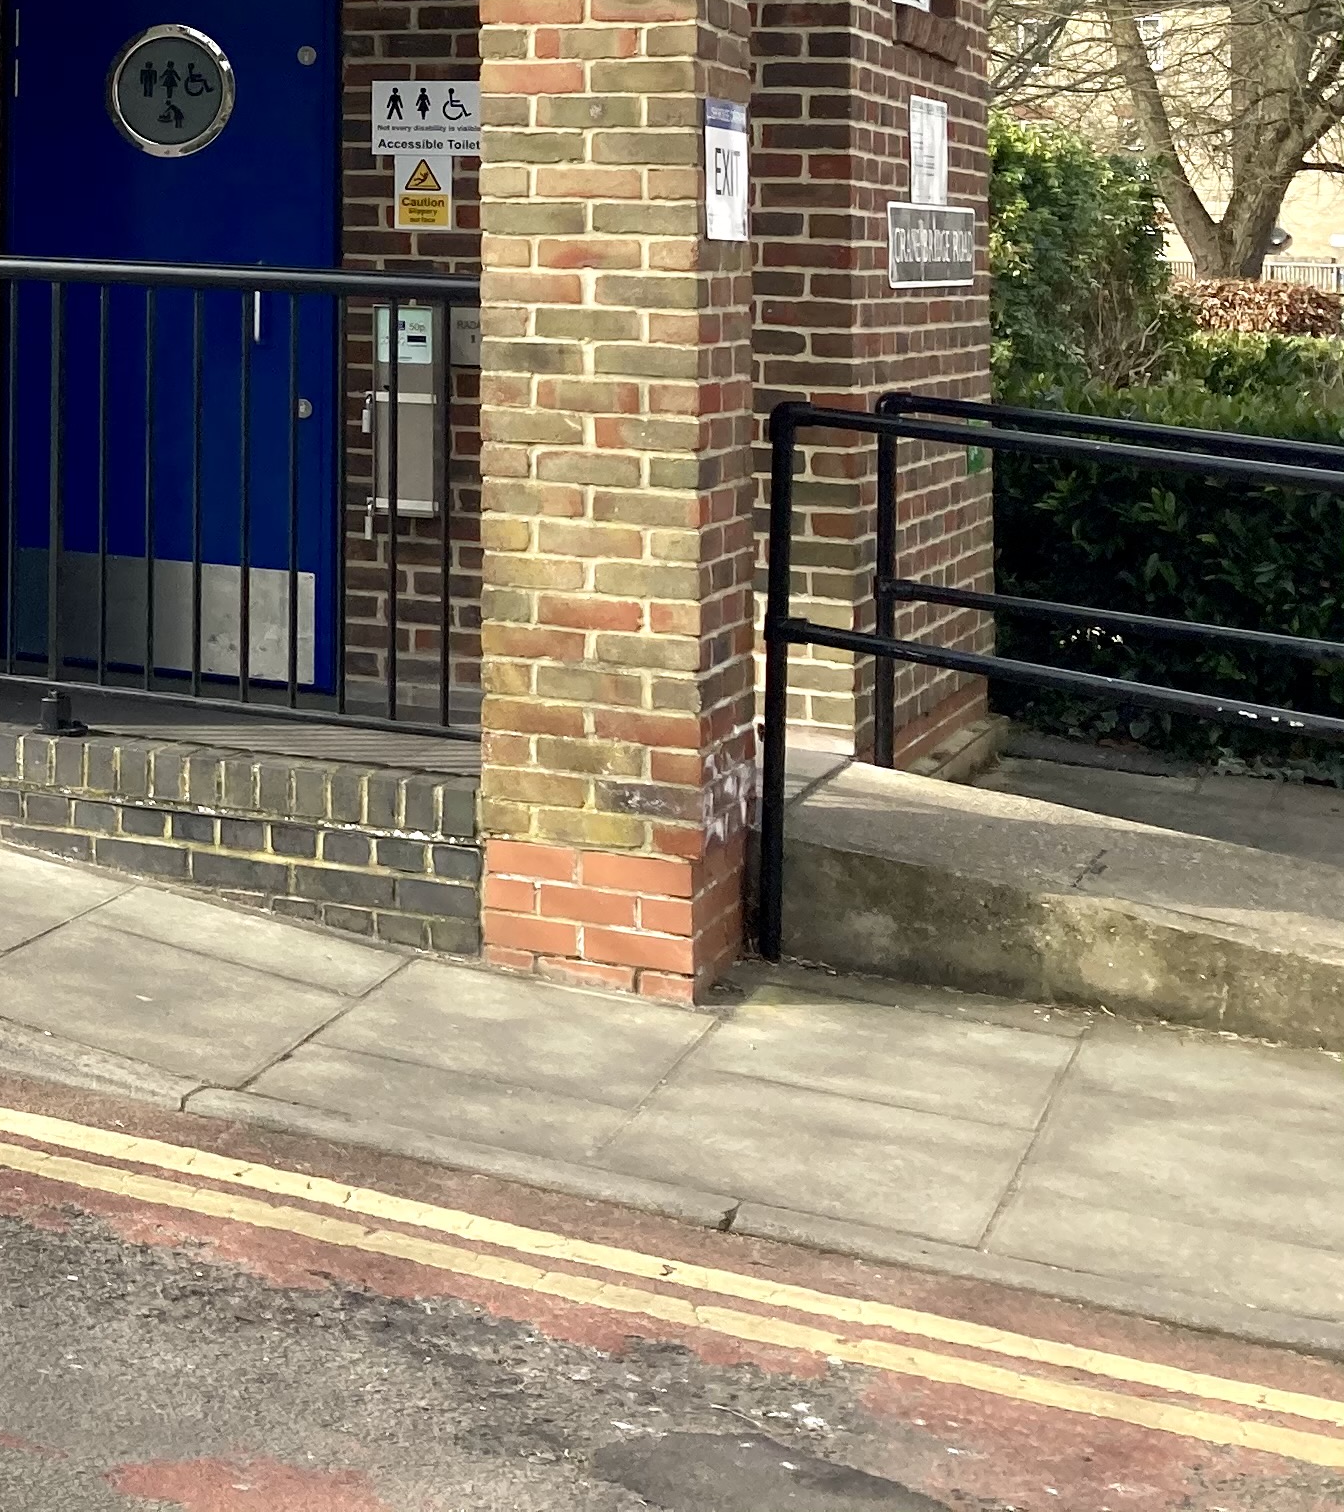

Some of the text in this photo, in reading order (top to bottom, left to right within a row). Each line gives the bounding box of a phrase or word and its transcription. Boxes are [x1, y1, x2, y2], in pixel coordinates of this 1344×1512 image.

[392, 125, 412, 133] every
[413, 125, 446, 133] disability
[378, 139, 481, 150] Accessible Toilet
[715, 147, 741, 197] EXIT
[401, 197, 445, 208] Caution
[408, 208, 438, 216] Slippery
[952, 230, 973, 263] ROAD
[408, 322, 426, 332] 50p
